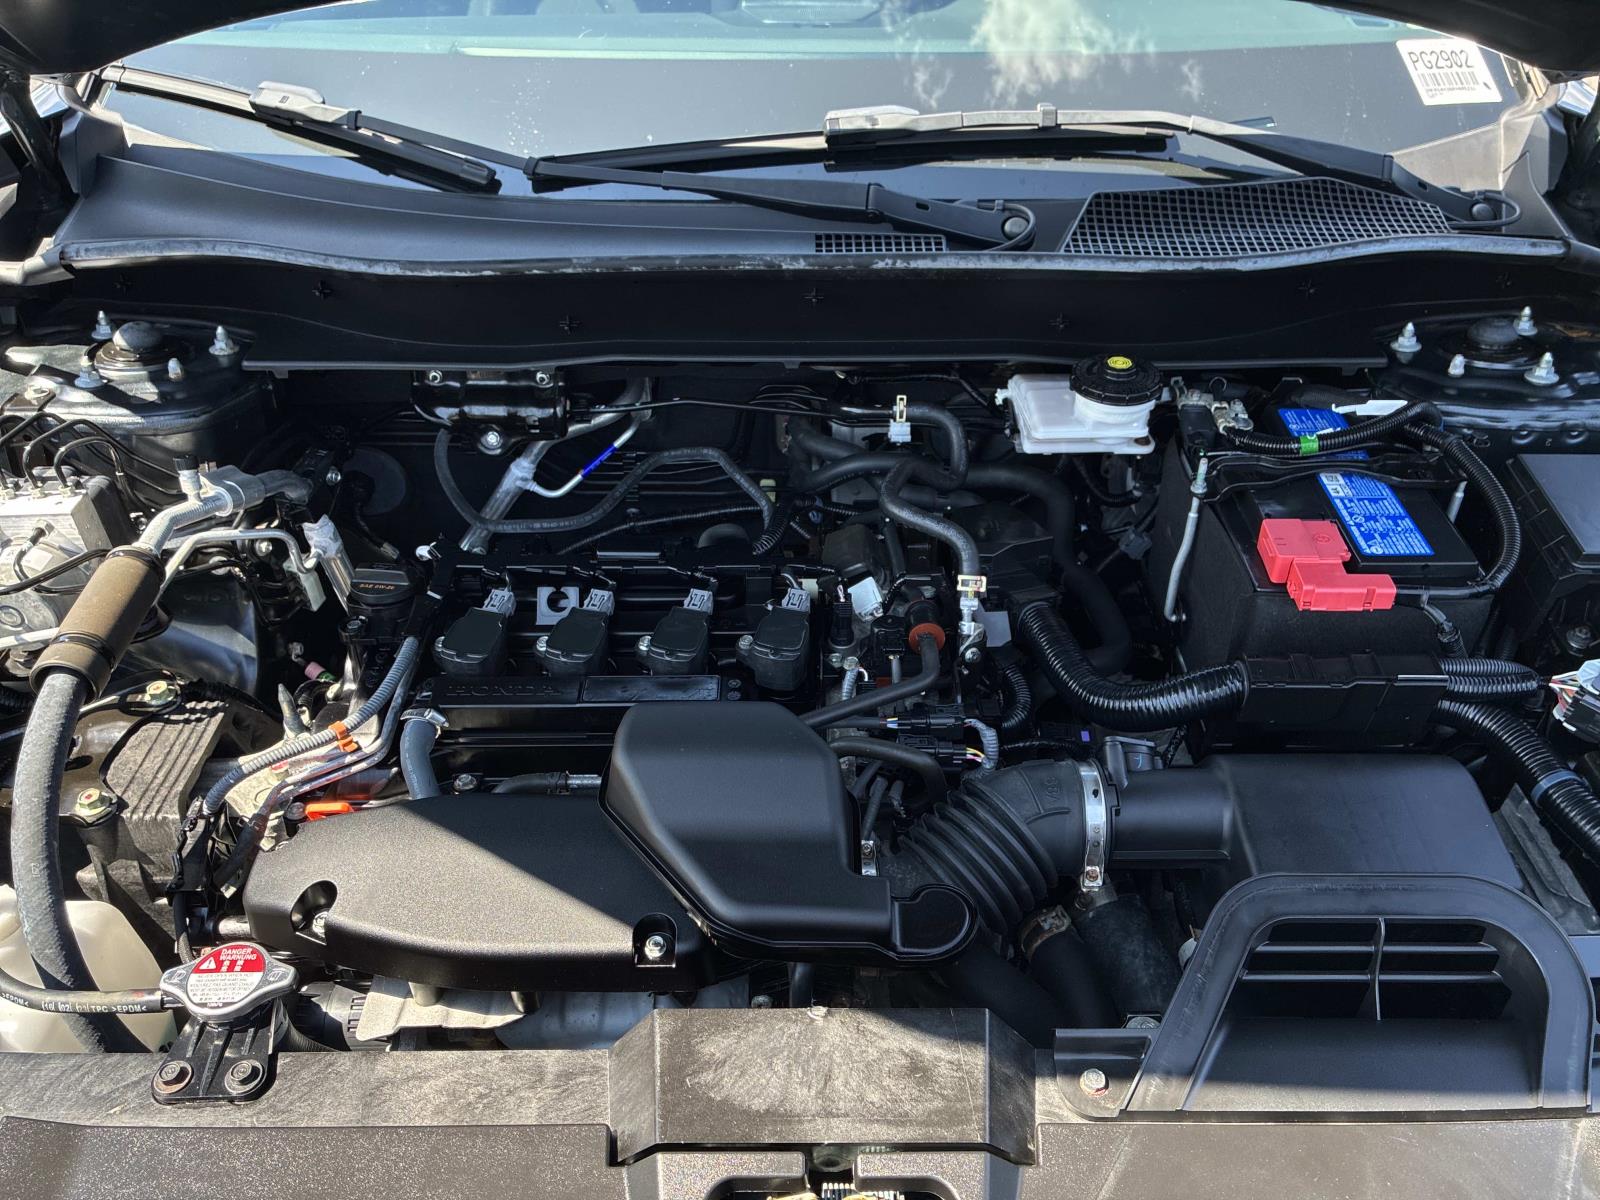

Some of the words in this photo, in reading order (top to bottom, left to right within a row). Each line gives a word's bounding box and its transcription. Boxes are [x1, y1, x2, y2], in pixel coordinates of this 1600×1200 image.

[1408, 49, 1474, 71] PG2902
[446, 685, 561, 696] HONDA
[221, 947, 253, 955] DANGER
[219, 953, 257, 961] WARNUNG
